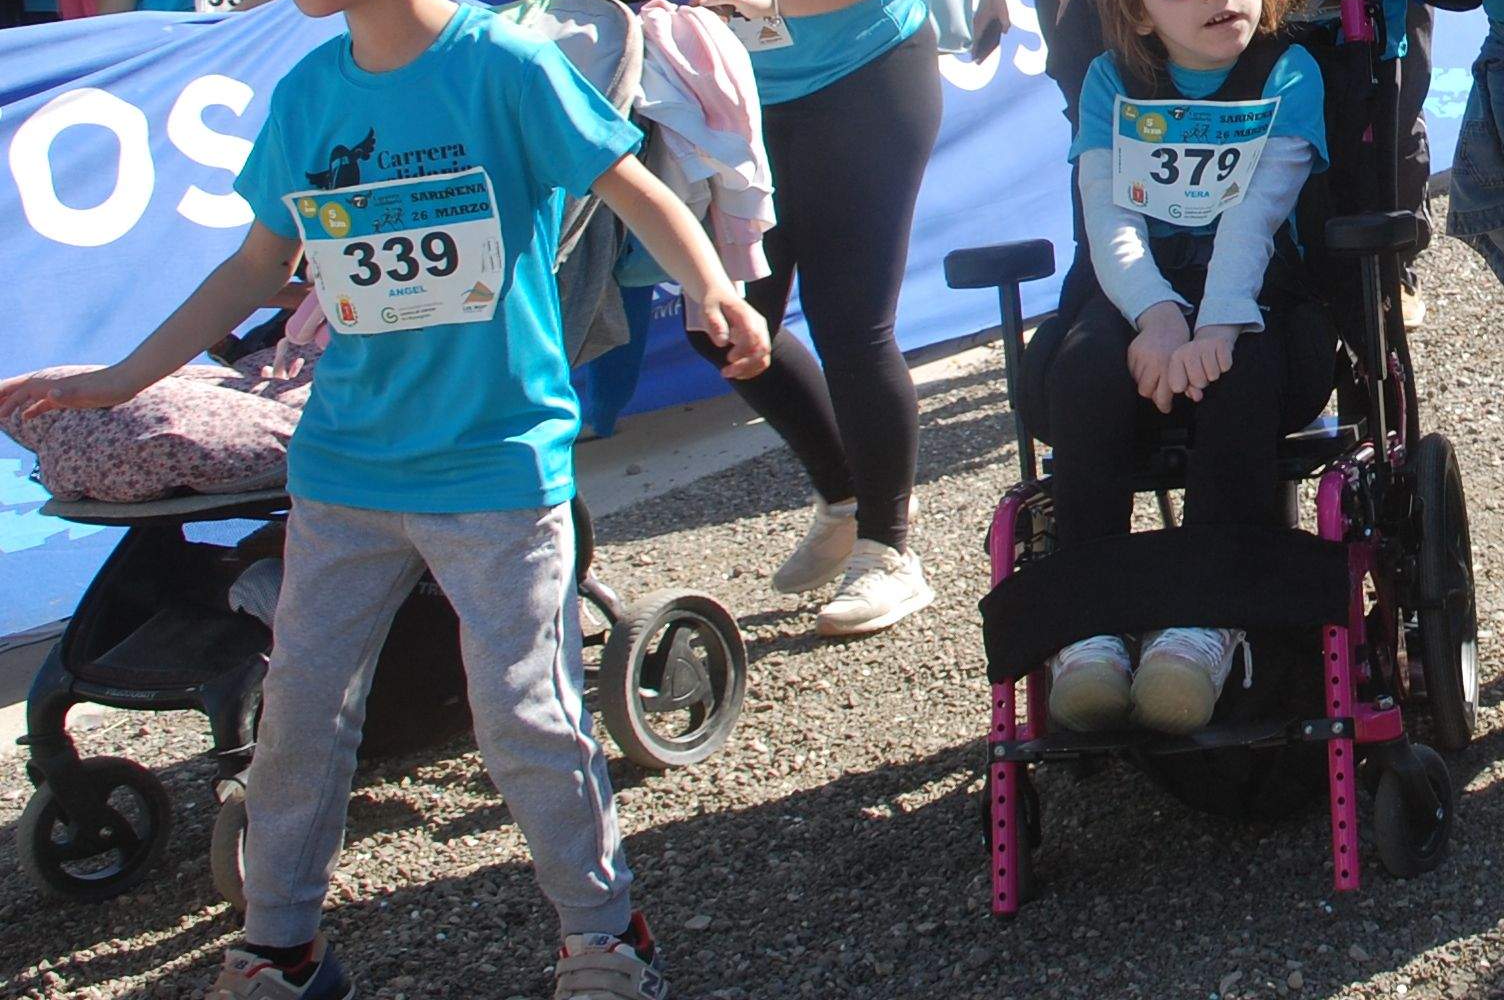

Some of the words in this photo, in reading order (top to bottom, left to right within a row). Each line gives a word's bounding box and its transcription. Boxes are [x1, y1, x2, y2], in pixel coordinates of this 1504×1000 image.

[377, 143, 467, 170] Carrera
[1150, 147, 1241, 186] 379
[410, 183, 487, 203] SARIÑENA
[1184, 190, 1210, 199] VERA
[411, 210, 429, 222] 26
[435, 202, 491, 219] MARZO
[342, 230, 460, 287] 339
[388, 286, 428, 298] ANGEL
